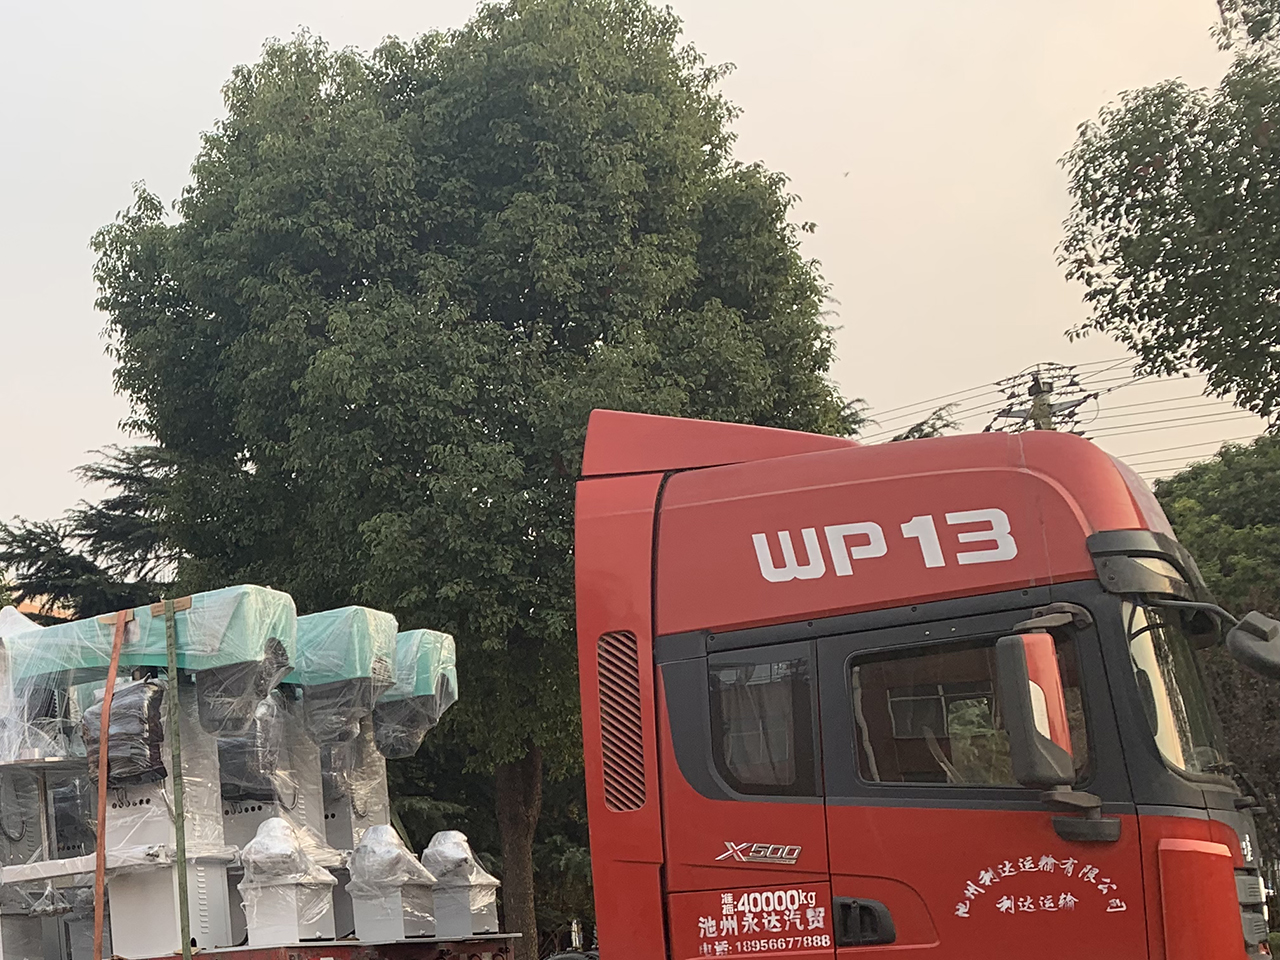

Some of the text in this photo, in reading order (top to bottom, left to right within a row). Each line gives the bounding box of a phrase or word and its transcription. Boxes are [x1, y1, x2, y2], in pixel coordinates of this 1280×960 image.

[715, 841, 802, 864] X500
[955, 855, 1127, 917] 池州利达运输有限公司
[996, 892, 1079, 914] 利达运输
[698, 907, 826, 938] 池州永达汽贸
